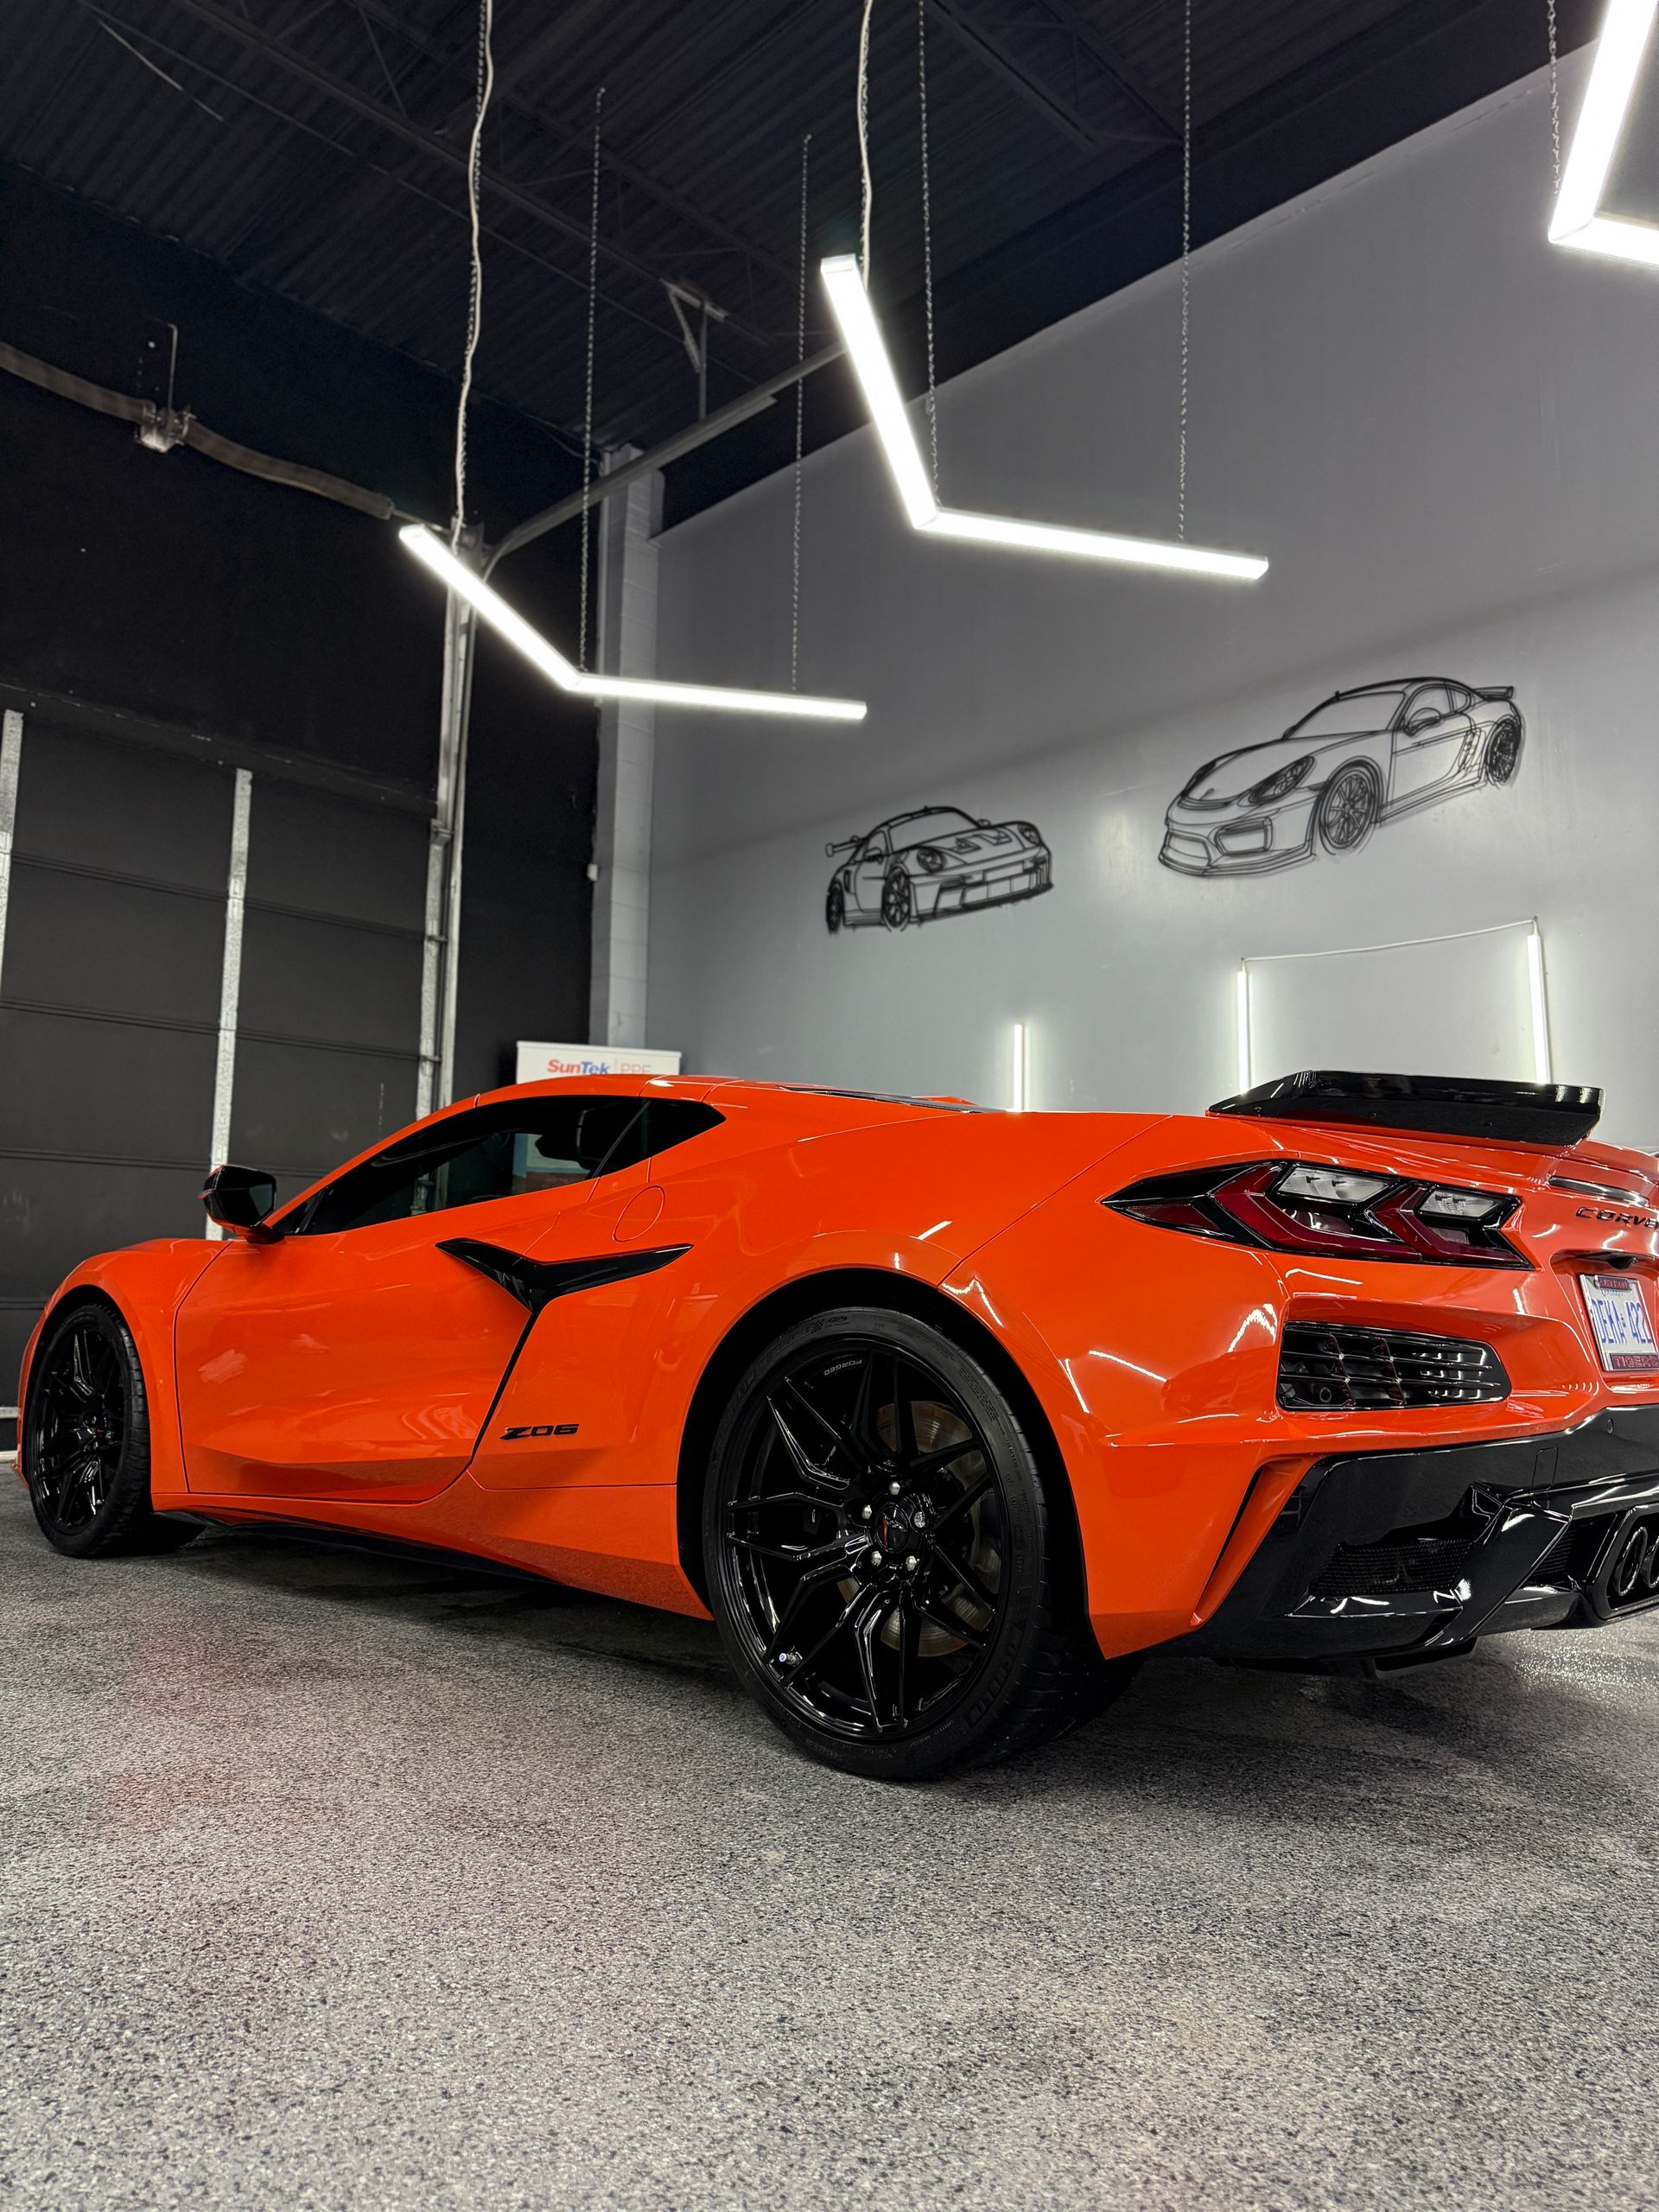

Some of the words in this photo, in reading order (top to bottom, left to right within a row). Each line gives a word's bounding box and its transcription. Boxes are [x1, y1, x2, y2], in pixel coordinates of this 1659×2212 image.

[547, 1058, 610, 1074] SunTek
[823, 1358, 862, 1376] FORGED
[499, 1423, 580, 1440] Z06
